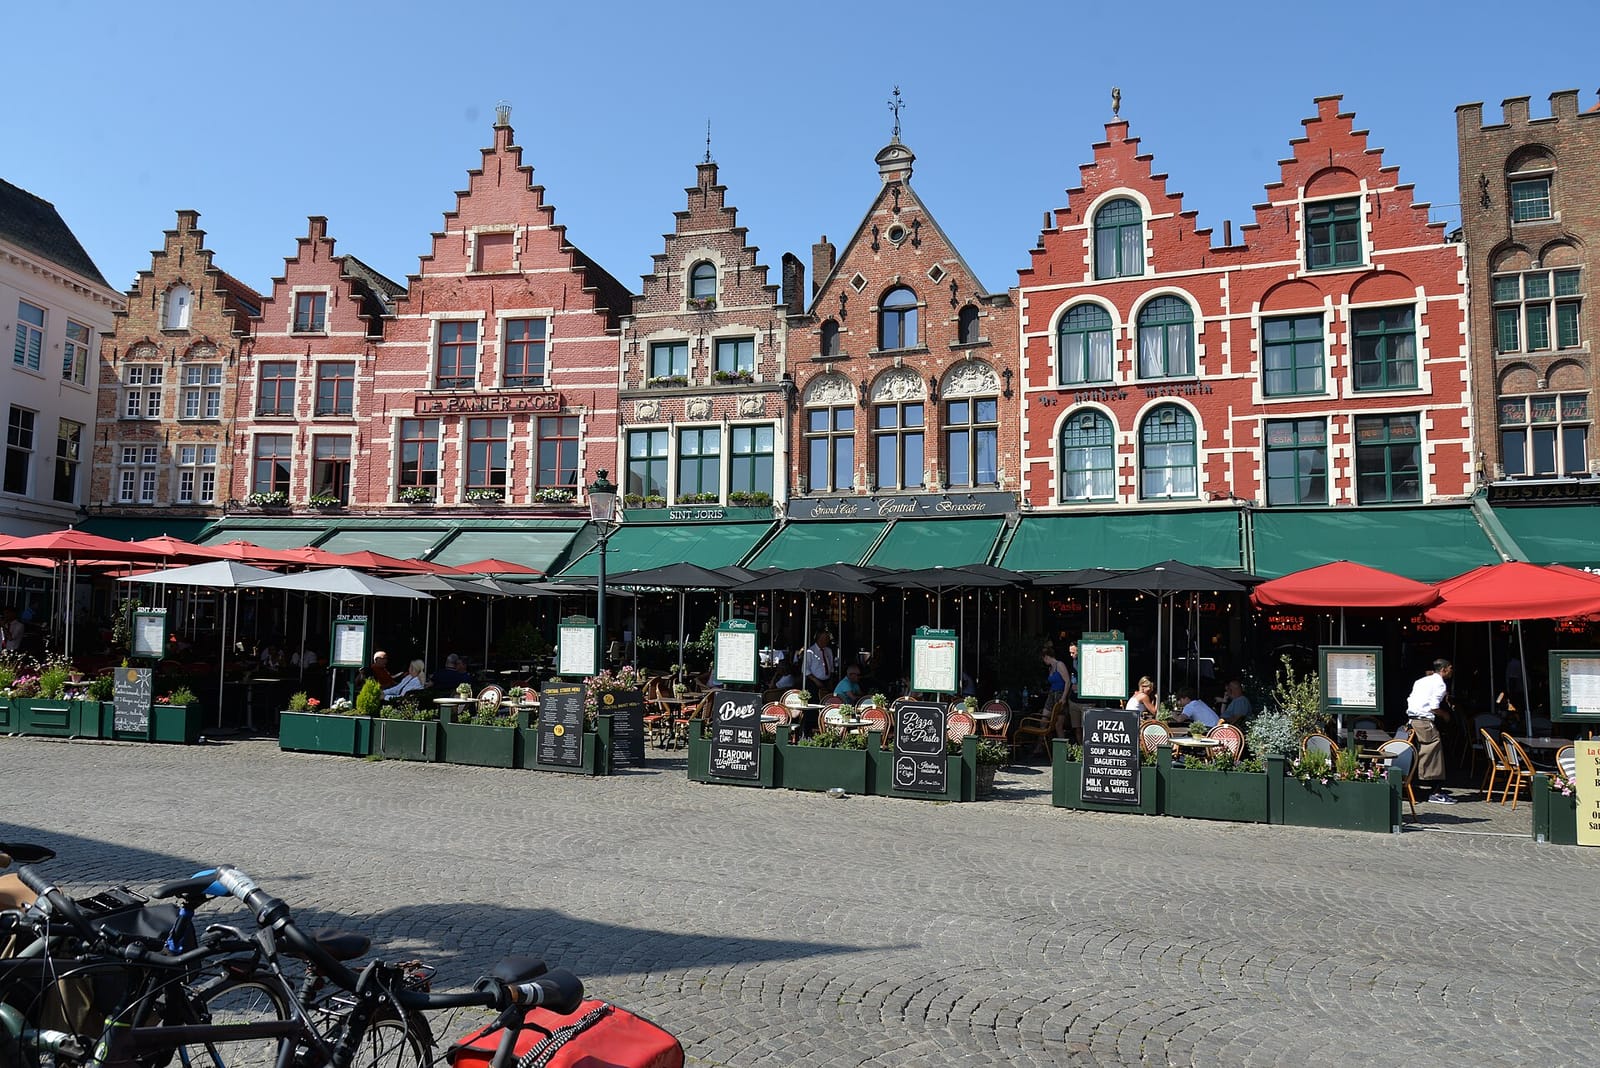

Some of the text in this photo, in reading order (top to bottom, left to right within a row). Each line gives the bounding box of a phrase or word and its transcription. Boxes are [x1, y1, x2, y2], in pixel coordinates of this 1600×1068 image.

[446, 396, 510, 412] PANIER
[811, 504, 838, 517] Grand
[878, 499, 917, 514] Central
[935, 501, 986, 512] Brasserie
[669, 510, 723, 519] SINT JORIS
[719, 701, 755, 721] Beer
[902, 712, 933, 729] Pizza
[1097, 720, 1125, 731] PIZZA
[738, 730, 753, 738] MILK
[910, 729, 940, 743] Pasta
[1091, 732, 1131, 744] & PASTA
[718, 749, 752, 760] TEAROOM
[1090, 747, 1131, 757] SOUP SALADS
[1094, 758, 1127, 766] BAGUETTES
[1086, 778, 1102, 786] MILK
[1111, 787, 1135, 795] WAFFLES
